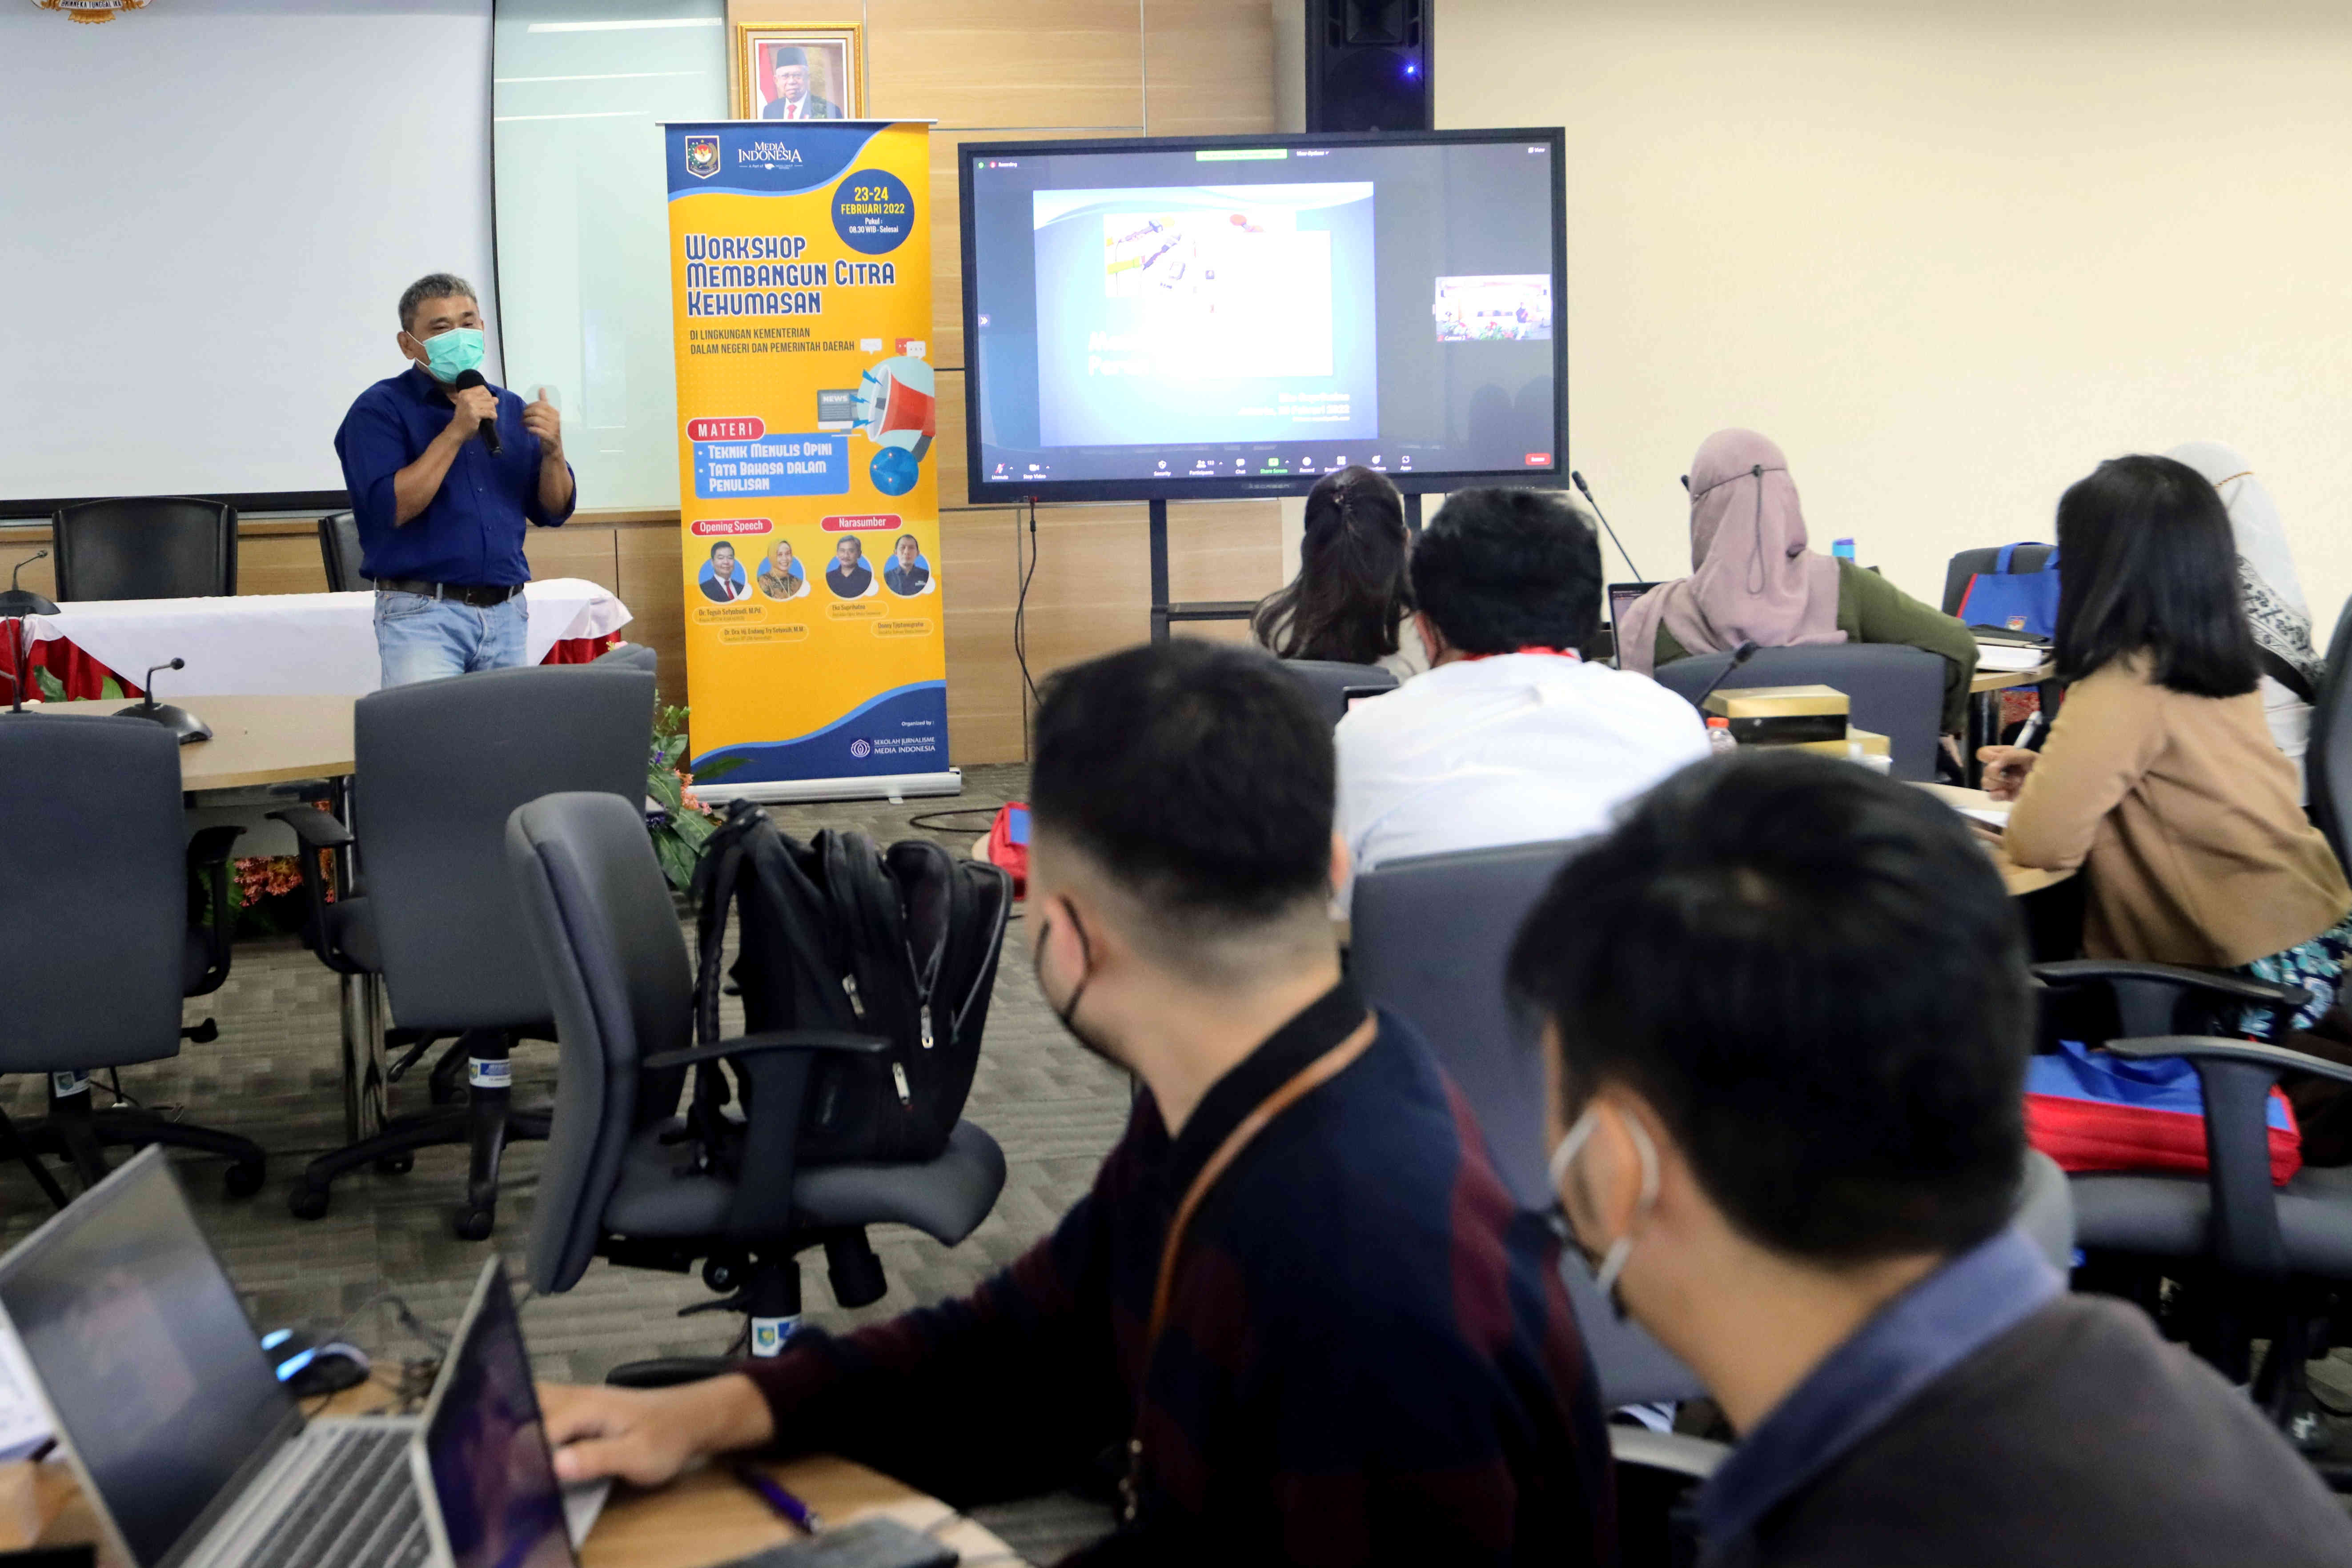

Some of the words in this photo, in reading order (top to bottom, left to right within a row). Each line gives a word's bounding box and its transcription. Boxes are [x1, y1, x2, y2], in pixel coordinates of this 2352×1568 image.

[738, 149, 802, 162] INDONESIA
[855, 187, 888, 201] 23-24
[841, 204, 882, 214] FEBRUARI
[883, 203, 905, 214] 2022
[690, 330, 698, 340] DI
[701, 329, 751, 340] LINGKUNGAN
[754, 328, 810, 338] KEMENTERIAN
[691, 344, 718, 354] DALAM
[721, 343, 750, 353] NEGERI
[752, 343, 768, 353] DAN
[771, 341, 820, 353] PEMERINTAH
[823, 341, 855, 351] DAERAH
[698, 422, 752, 437] MATERI
[700, 521, 733, 533] Opening
[734, 521, 763, 532] Speech
[839, 517, 886, 528] Narasumber
[901, 736, 935, 745] JURNALISME
[899, 745, 935, 753] INDONESIA
